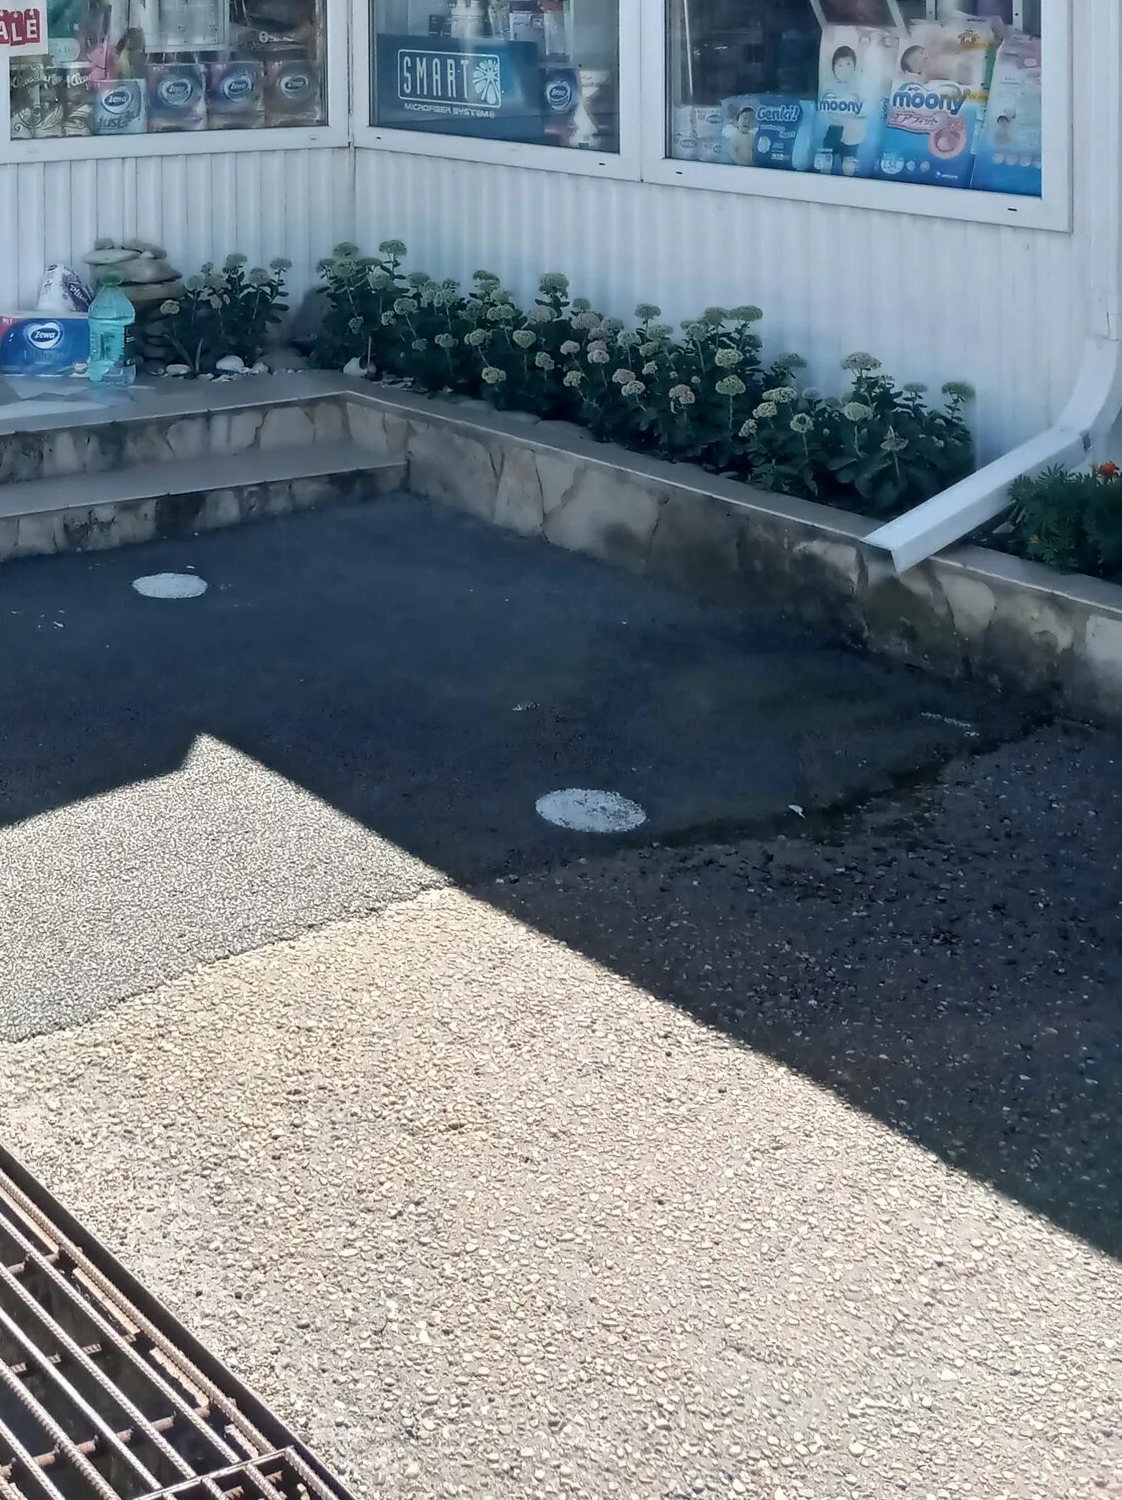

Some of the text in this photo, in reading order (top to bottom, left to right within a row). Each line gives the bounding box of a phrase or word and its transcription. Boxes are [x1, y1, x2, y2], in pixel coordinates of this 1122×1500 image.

[403, 55, 470, 99] SMART
[819, 99, 864, 114] moony
[893, 90, 966, 115] moony
[757, 104, 799, 121] Genki!
[34, 330, 56, 339] Zewa
